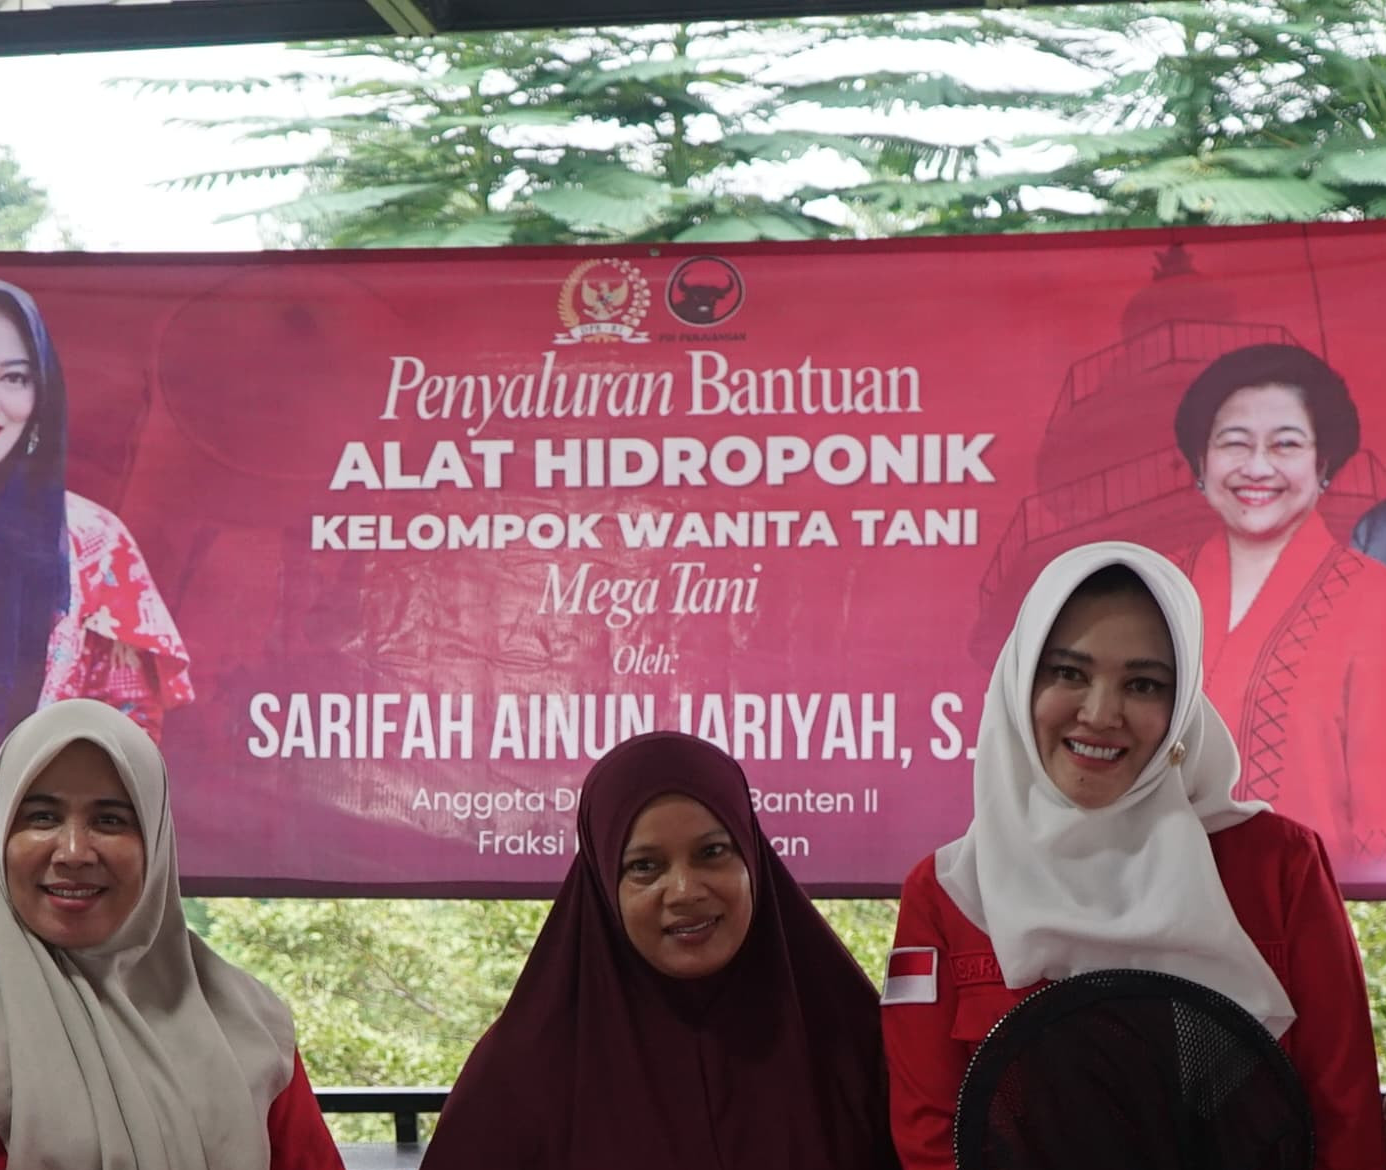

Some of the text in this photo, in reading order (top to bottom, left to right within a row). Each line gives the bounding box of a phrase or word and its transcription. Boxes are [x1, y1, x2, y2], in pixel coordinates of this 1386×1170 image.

[379, 350, 923, 436] Penyaluran Bantuan
[329, 433, 996, 490] ALAT HIDROPONIK
[310, 508, 979, 551] KELOMPOK WANITA TANI
[538, 562, 762, 629] Mega Tani
[612, 645, 680, 676] Oleh:
[247, 691, 474, 760] SARIFAH
[489, 692, 655, 760] AINUN
[412, 787, 545, 820] Anggota
[749, 787, 854, 813] Banten
[478, 828, 565, 855] Fraksi
